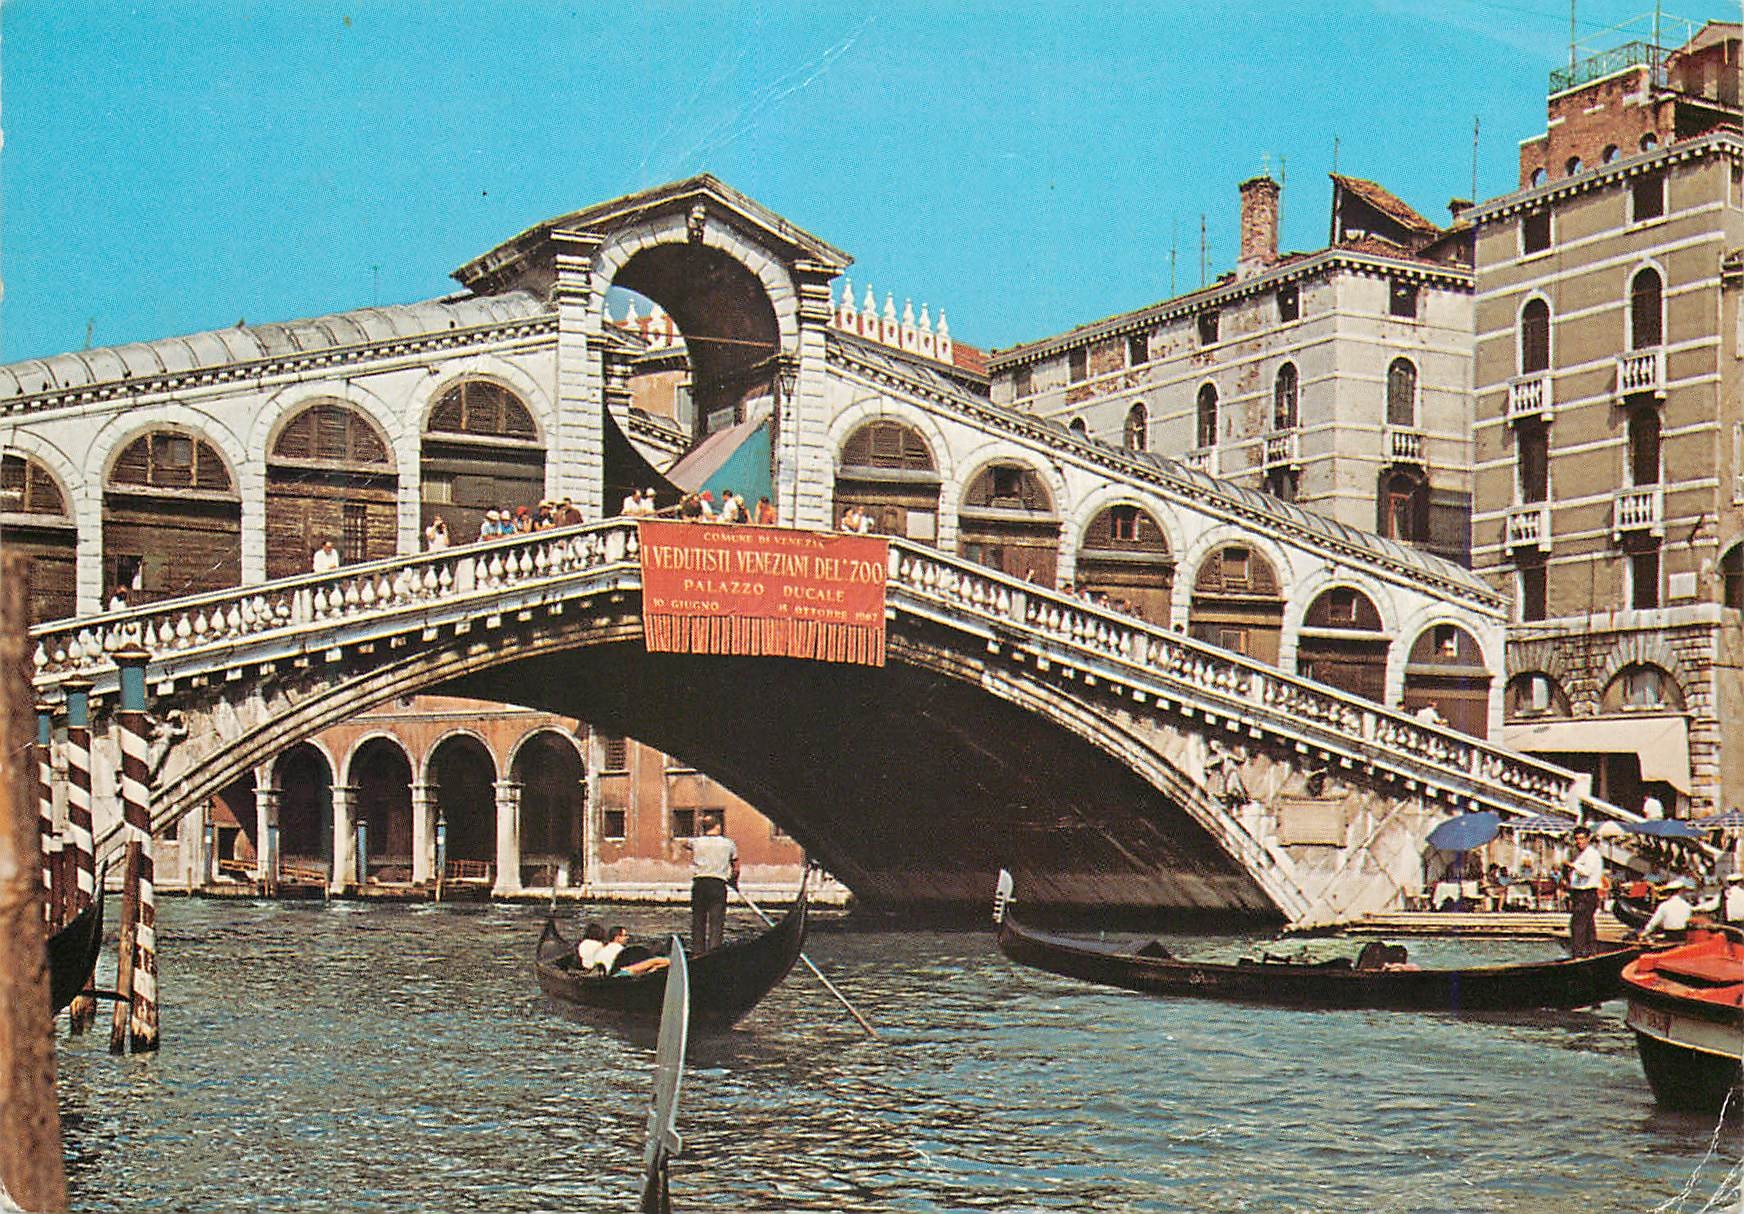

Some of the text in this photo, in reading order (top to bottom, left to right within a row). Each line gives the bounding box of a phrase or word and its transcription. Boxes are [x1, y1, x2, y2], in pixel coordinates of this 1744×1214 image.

[703, 531, 753, 543] COMUNE
[758, 535, 770, 544] DI
[653, 545, 731, 574] VEDUTISTI
[737, 550, 809, 578] VENEZIANI
[684, 578, 845, 603] PALAZZO DUCALE
[671, 599, 720, 611] GIUGNO
